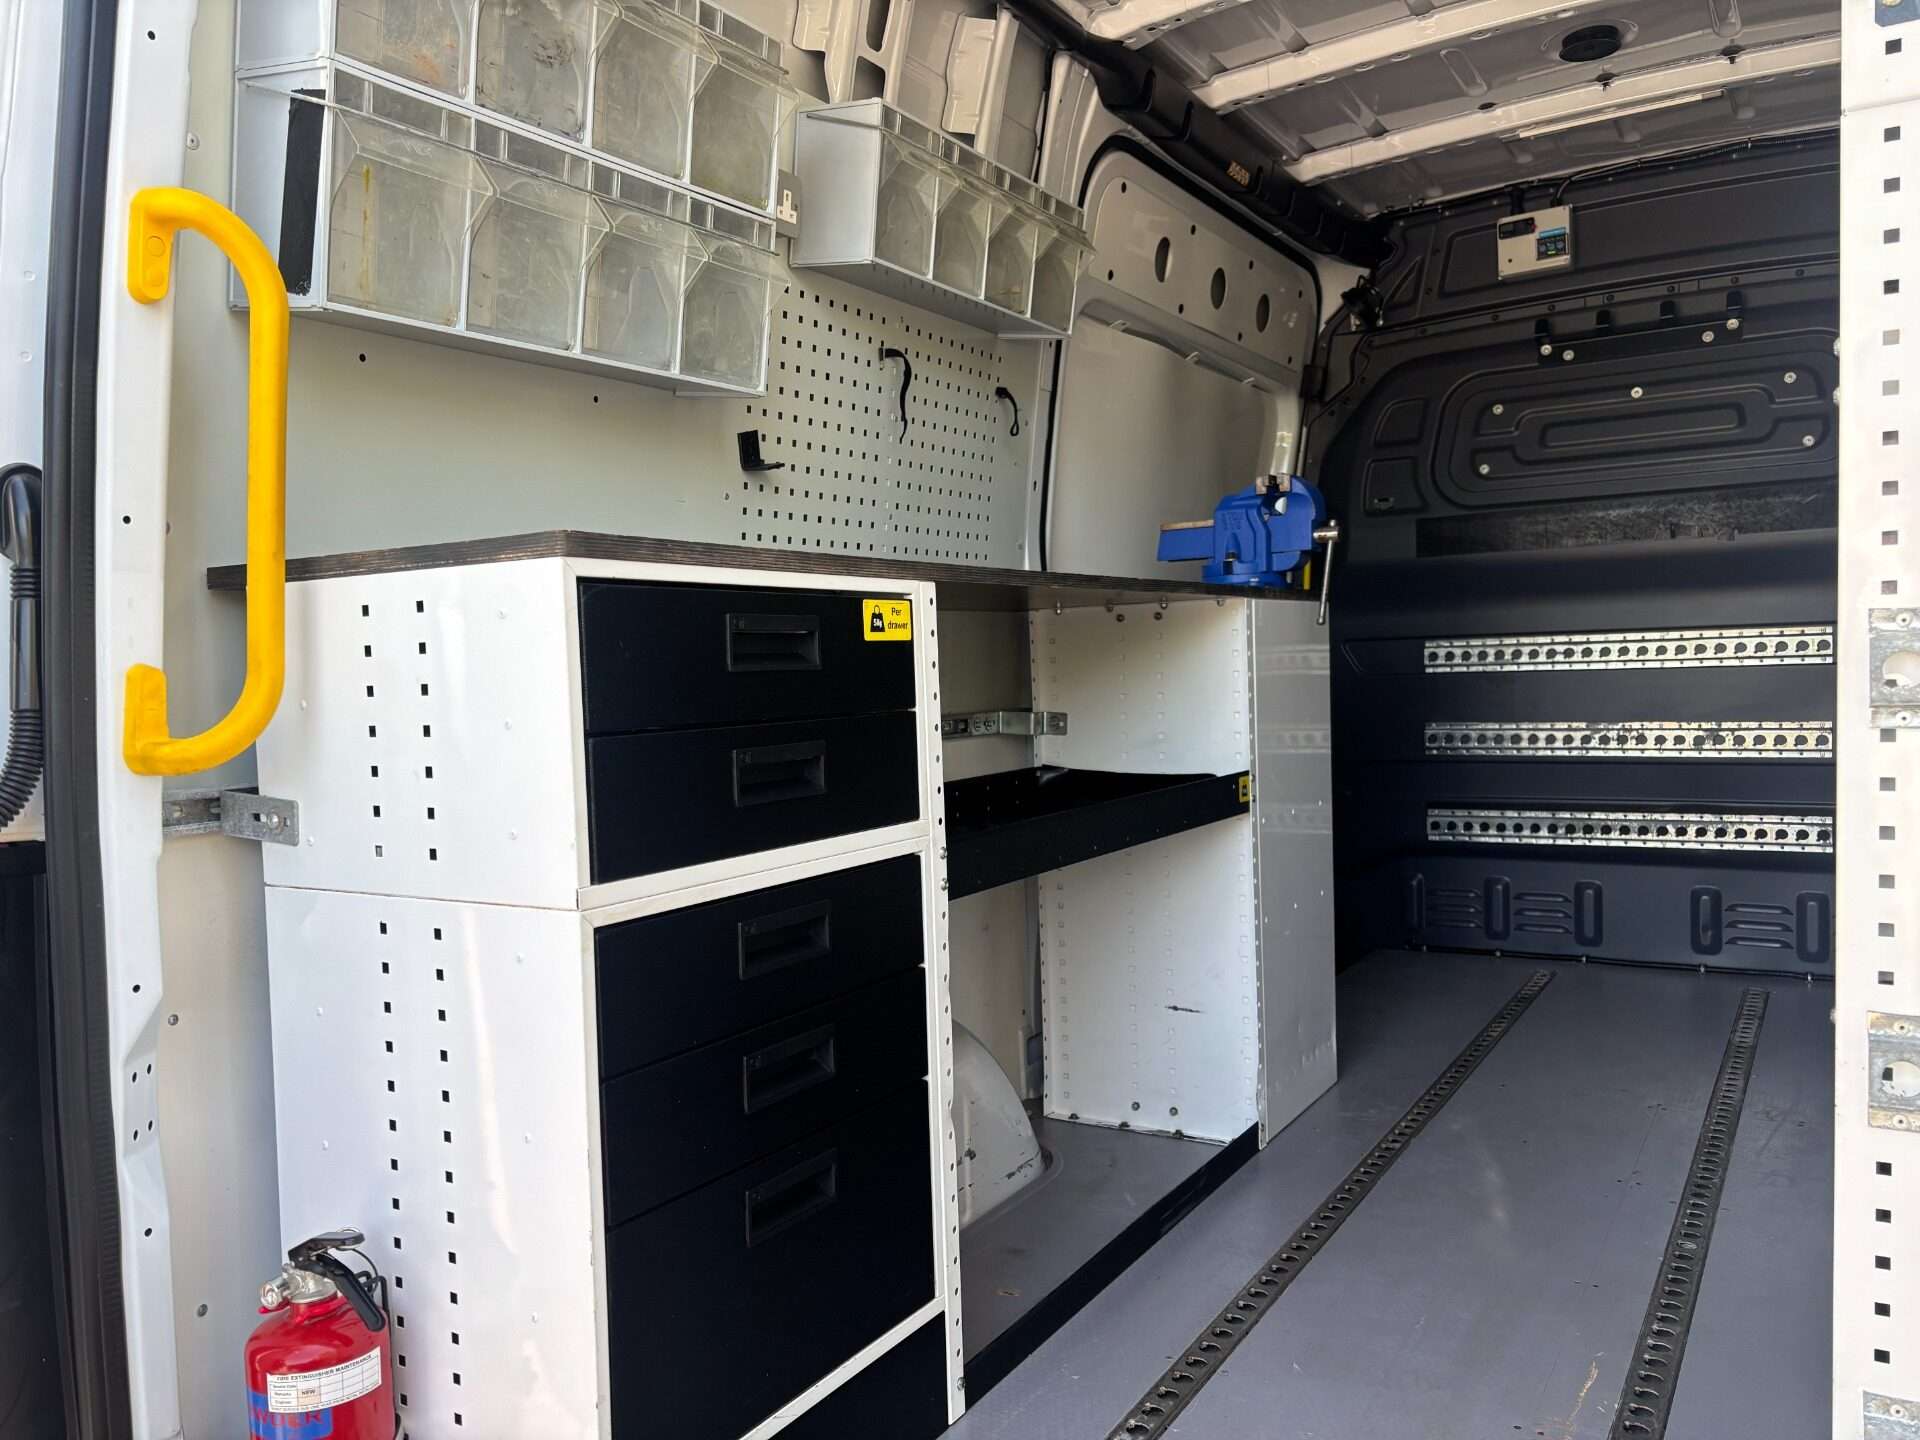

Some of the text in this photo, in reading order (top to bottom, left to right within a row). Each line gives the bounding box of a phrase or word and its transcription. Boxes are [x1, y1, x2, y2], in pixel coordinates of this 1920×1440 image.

[892, 607, 902, 616] Per
[887, 620, 908, 630] drawer
[291, 1369, 334, 1380] EXTINGUISHER
[335, 1355, 372, 1372] MAINTENANCE
[251, 1408, 322, 1426] WDER
